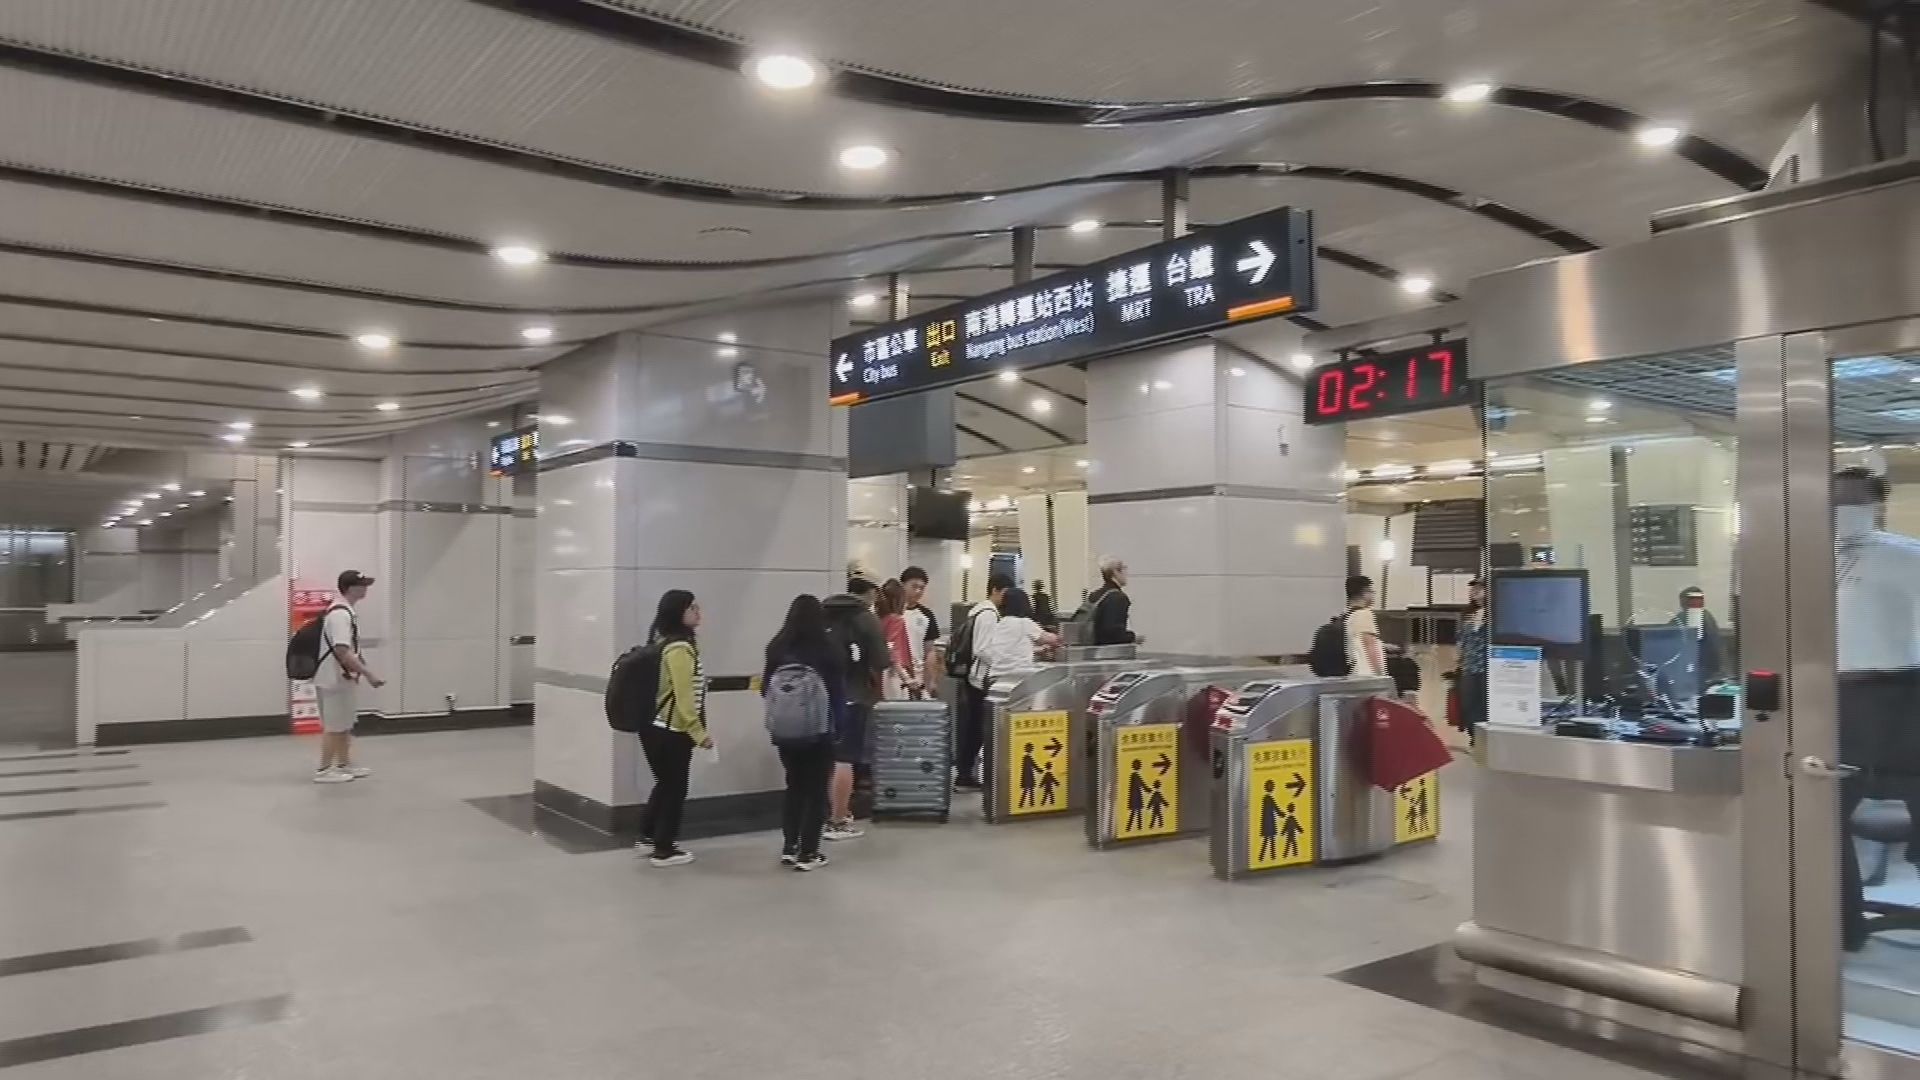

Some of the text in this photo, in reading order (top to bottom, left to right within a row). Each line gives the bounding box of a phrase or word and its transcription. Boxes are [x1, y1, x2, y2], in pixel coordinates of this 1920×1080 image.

[1107, 262, 1153, 301] 捷運
[965, 278, 1094, 339] 南港轉運站西站
[1122, 298, 1153, 323] MRT
[1185, 285, 1216, 308] TRA
[863, 328, 918, 364] 市區公車
[926, 320, 957, 349] 出口
[966, 338, 1007, 360] Nangang
[1007, 331, 1025, 349] bus
[931, 350, 951, 367] Exit
[864, 363, 899, 384] City bus
[1317, 351, 1452, 414] 02:17
